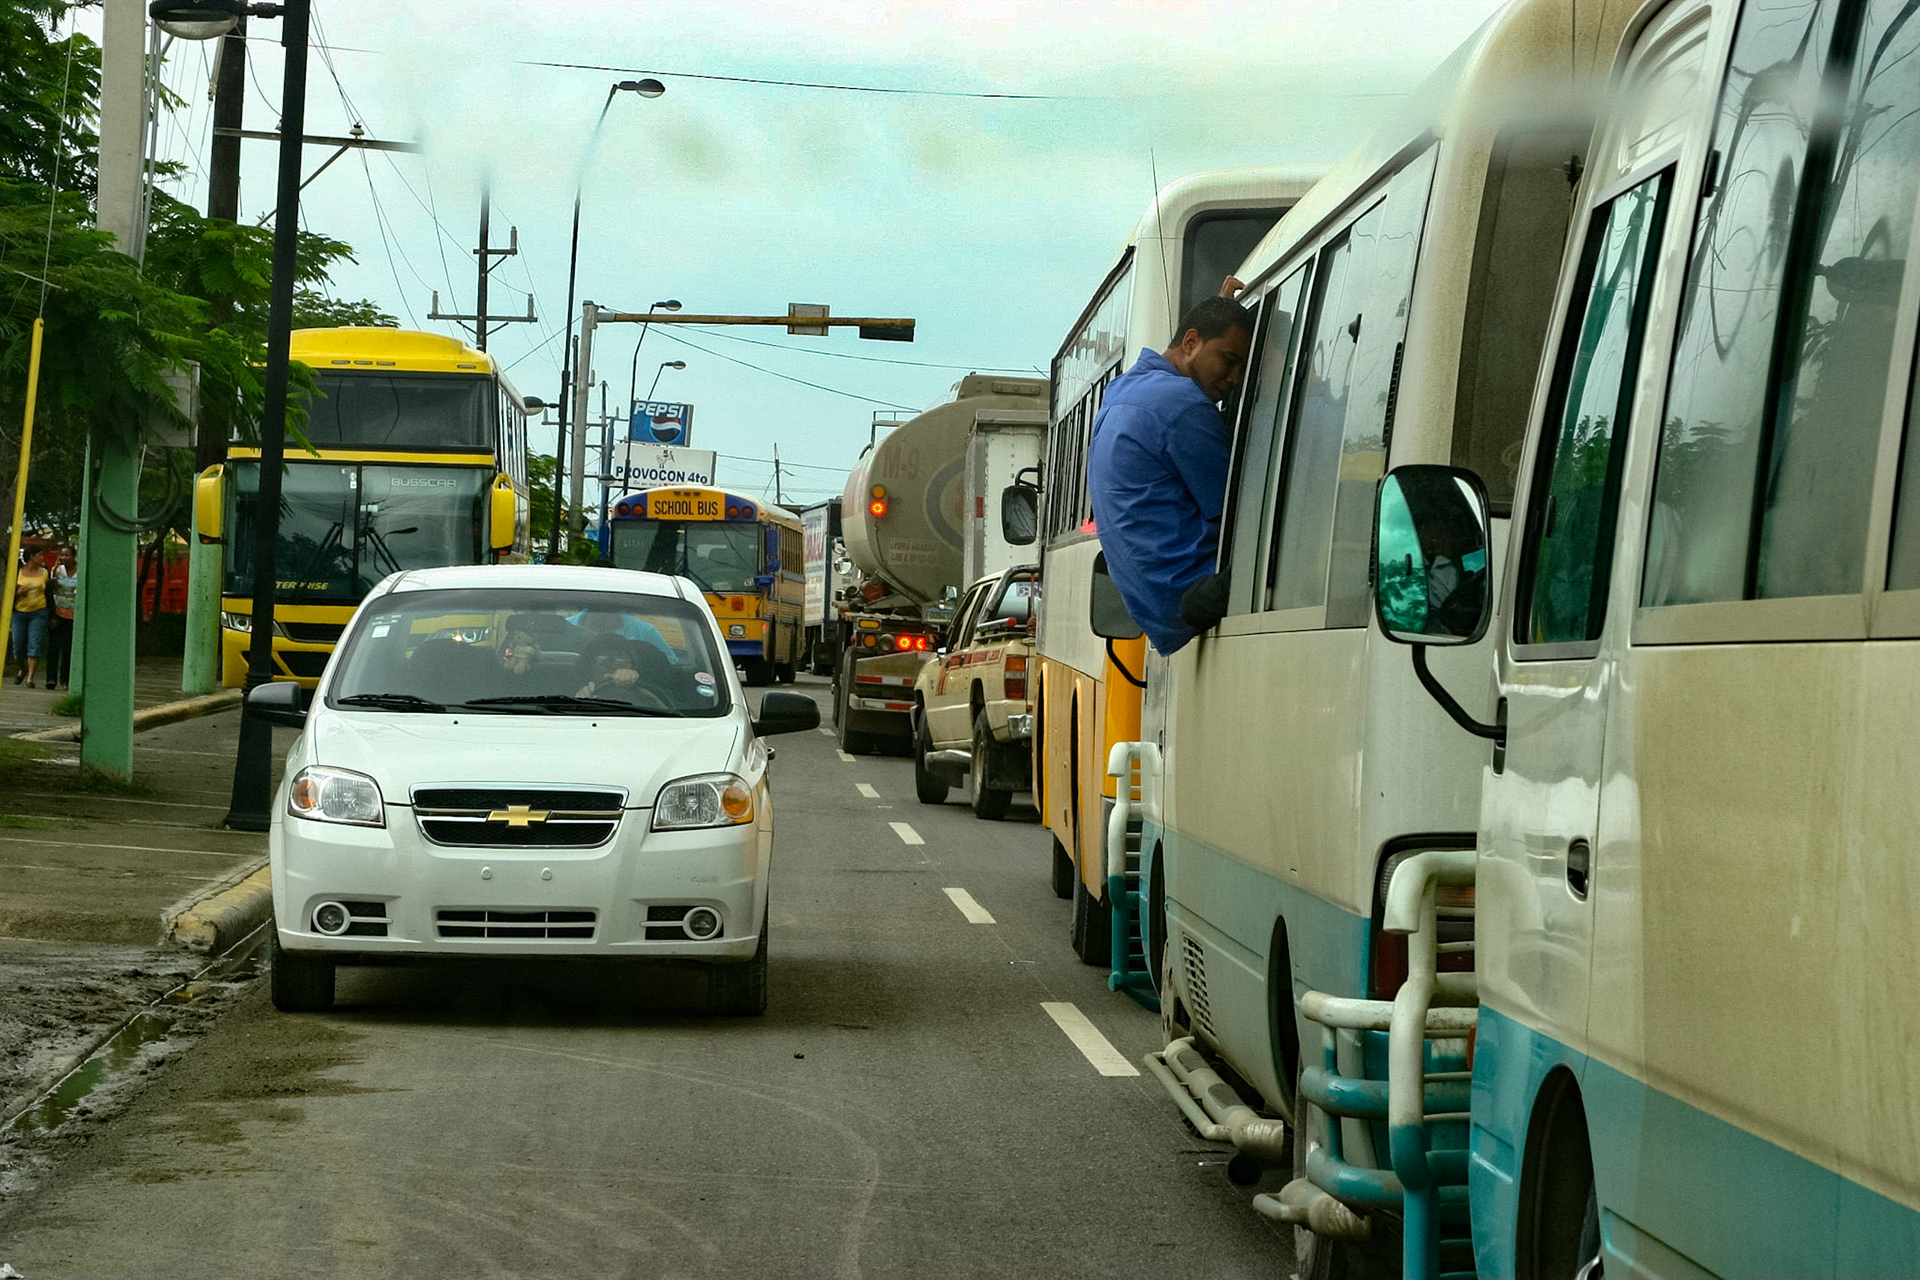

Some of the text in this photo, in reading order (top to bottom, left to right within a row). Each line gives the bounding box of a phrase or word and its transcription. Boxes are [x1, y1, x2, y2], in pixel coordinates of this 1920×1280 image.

[634, 402, 685, 419] PEPSI
[391, 477, 457, 488] BUSSCAR
[688, 472, 708, 484] 4to
[654, 500, 718, 516] SCHOOL BUS
